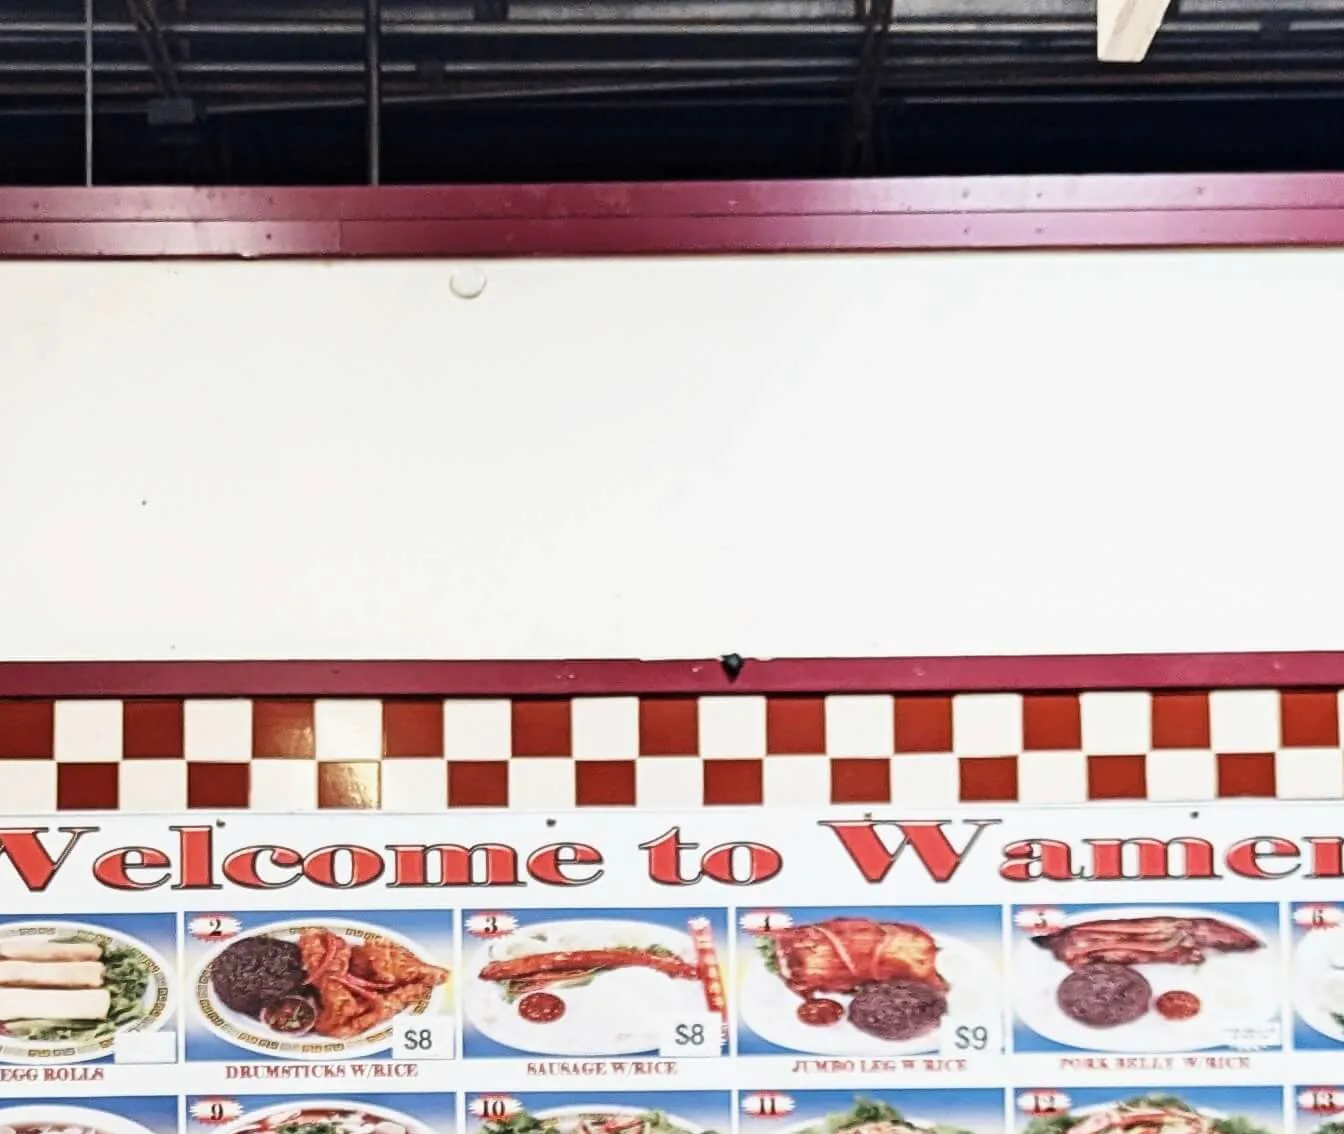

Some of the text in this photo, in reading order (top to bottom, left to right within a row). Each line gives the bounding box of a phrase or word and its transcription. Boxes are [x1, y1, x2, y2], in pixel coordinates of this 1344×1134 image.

[638, 825, 783, 886] to
[208, 918, 223, 938] 2
[483, 915, 498, 935] 3
[403, 1029, 433, 1050] $8
[674, 1023, 705, 1046] $8
[955, 1025, 989, 1049] $9
[225, 1063, 419, 1080] DRUMSTICKS W/RICE
[526, 1061, 678, 1076] SAUSAGE W/RICE
[792, 1060, 855, 1073] JUMBO
[860, 1060, 896, 1072] LEG
[1115, 1057, 1174, 1069] BELLY
[0, 1067, 105, 1082] EGG ROLLS
[210, 1104, 223, 1121] 9
[482, 1100, 506, 1118] 10
